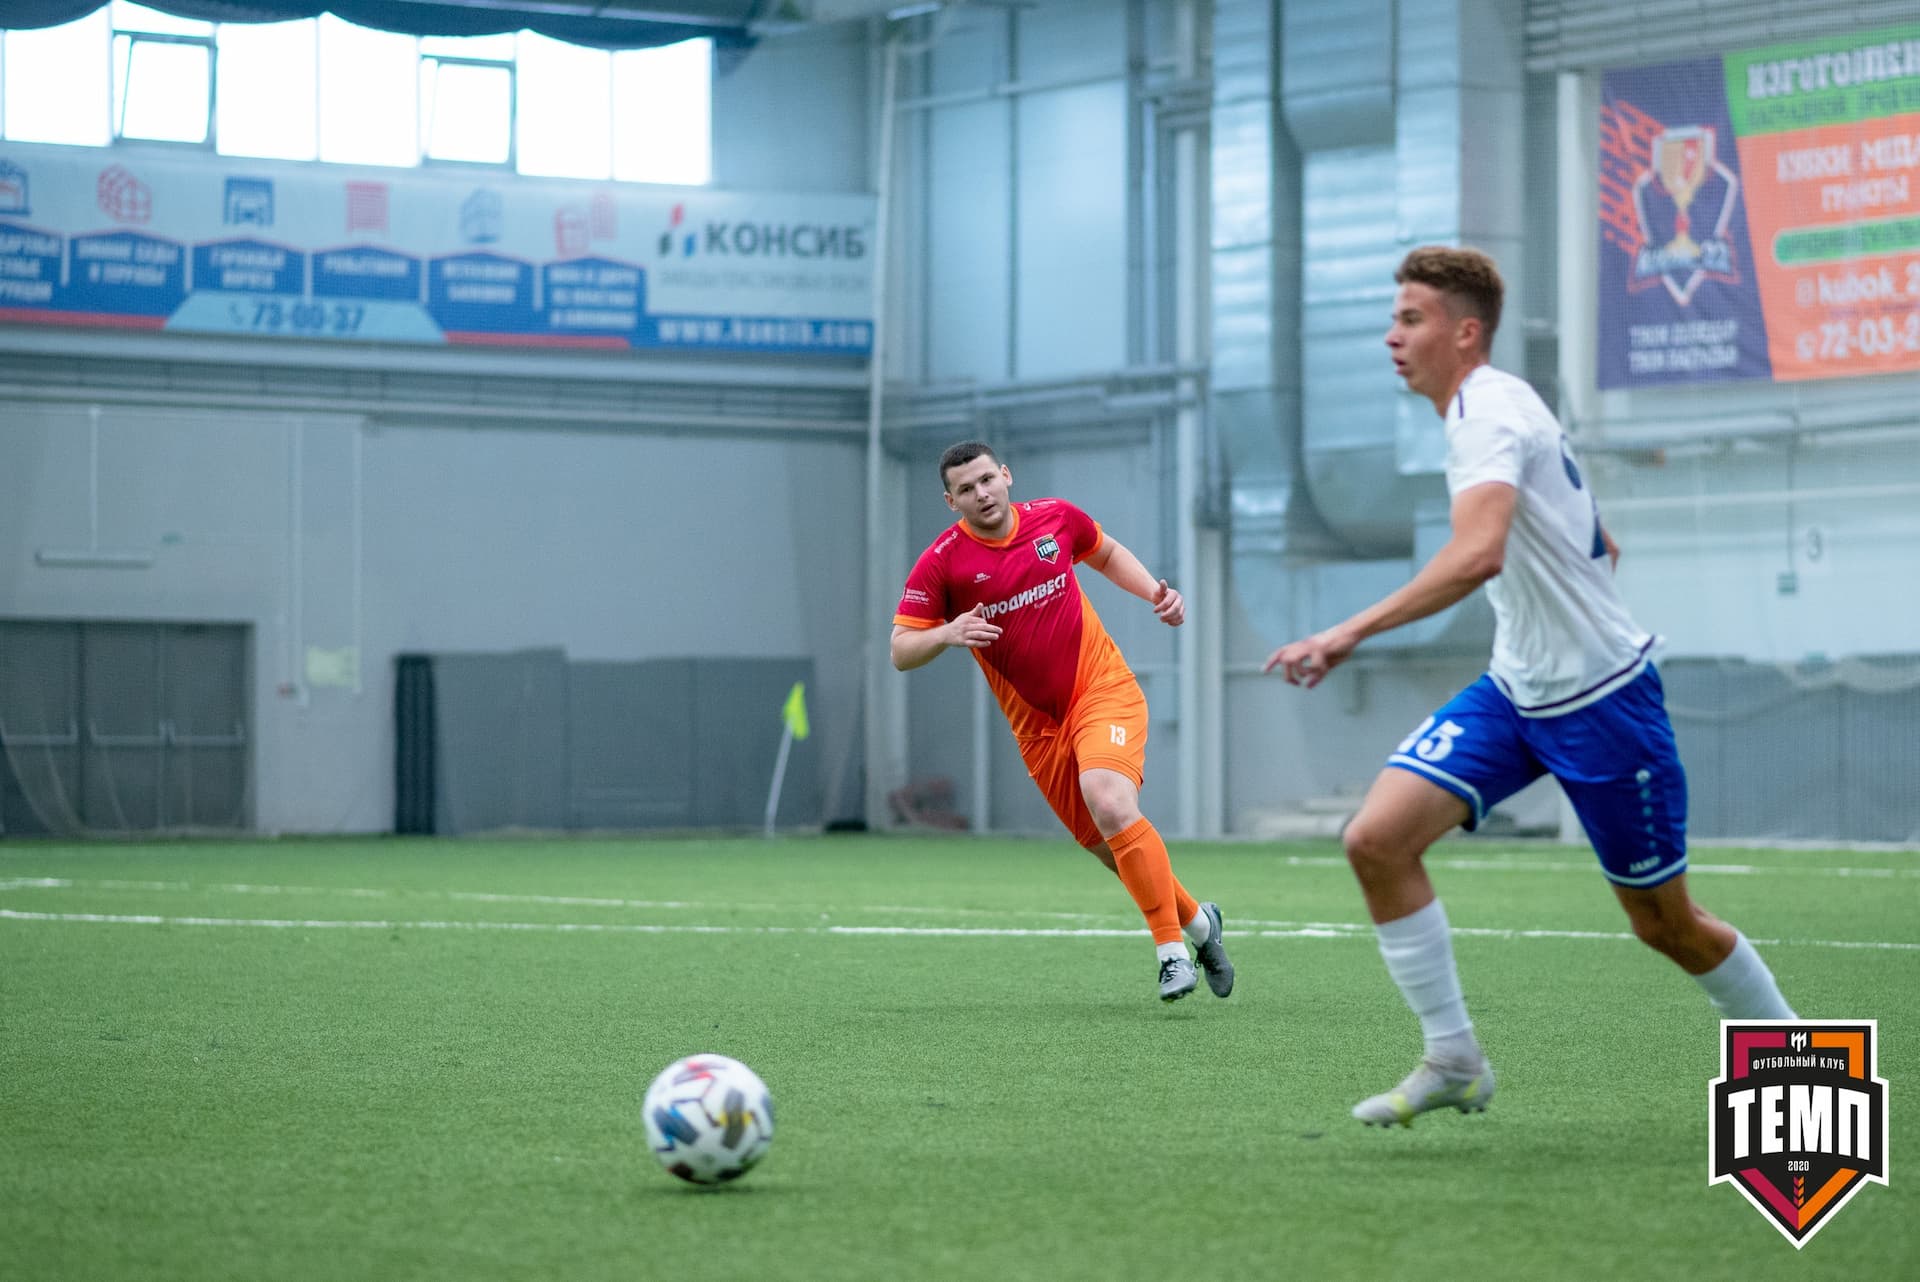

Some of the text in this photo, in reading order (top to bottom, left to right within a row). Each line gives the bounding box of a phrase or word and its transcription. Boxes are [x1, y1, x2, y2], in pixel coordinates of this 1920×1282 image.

[704, 221, 864, 258] КОНСИБ
[981, 573, 1066, 620] ПРОДИНВЕСТ
[1109, 724, 1126, 746] 13
